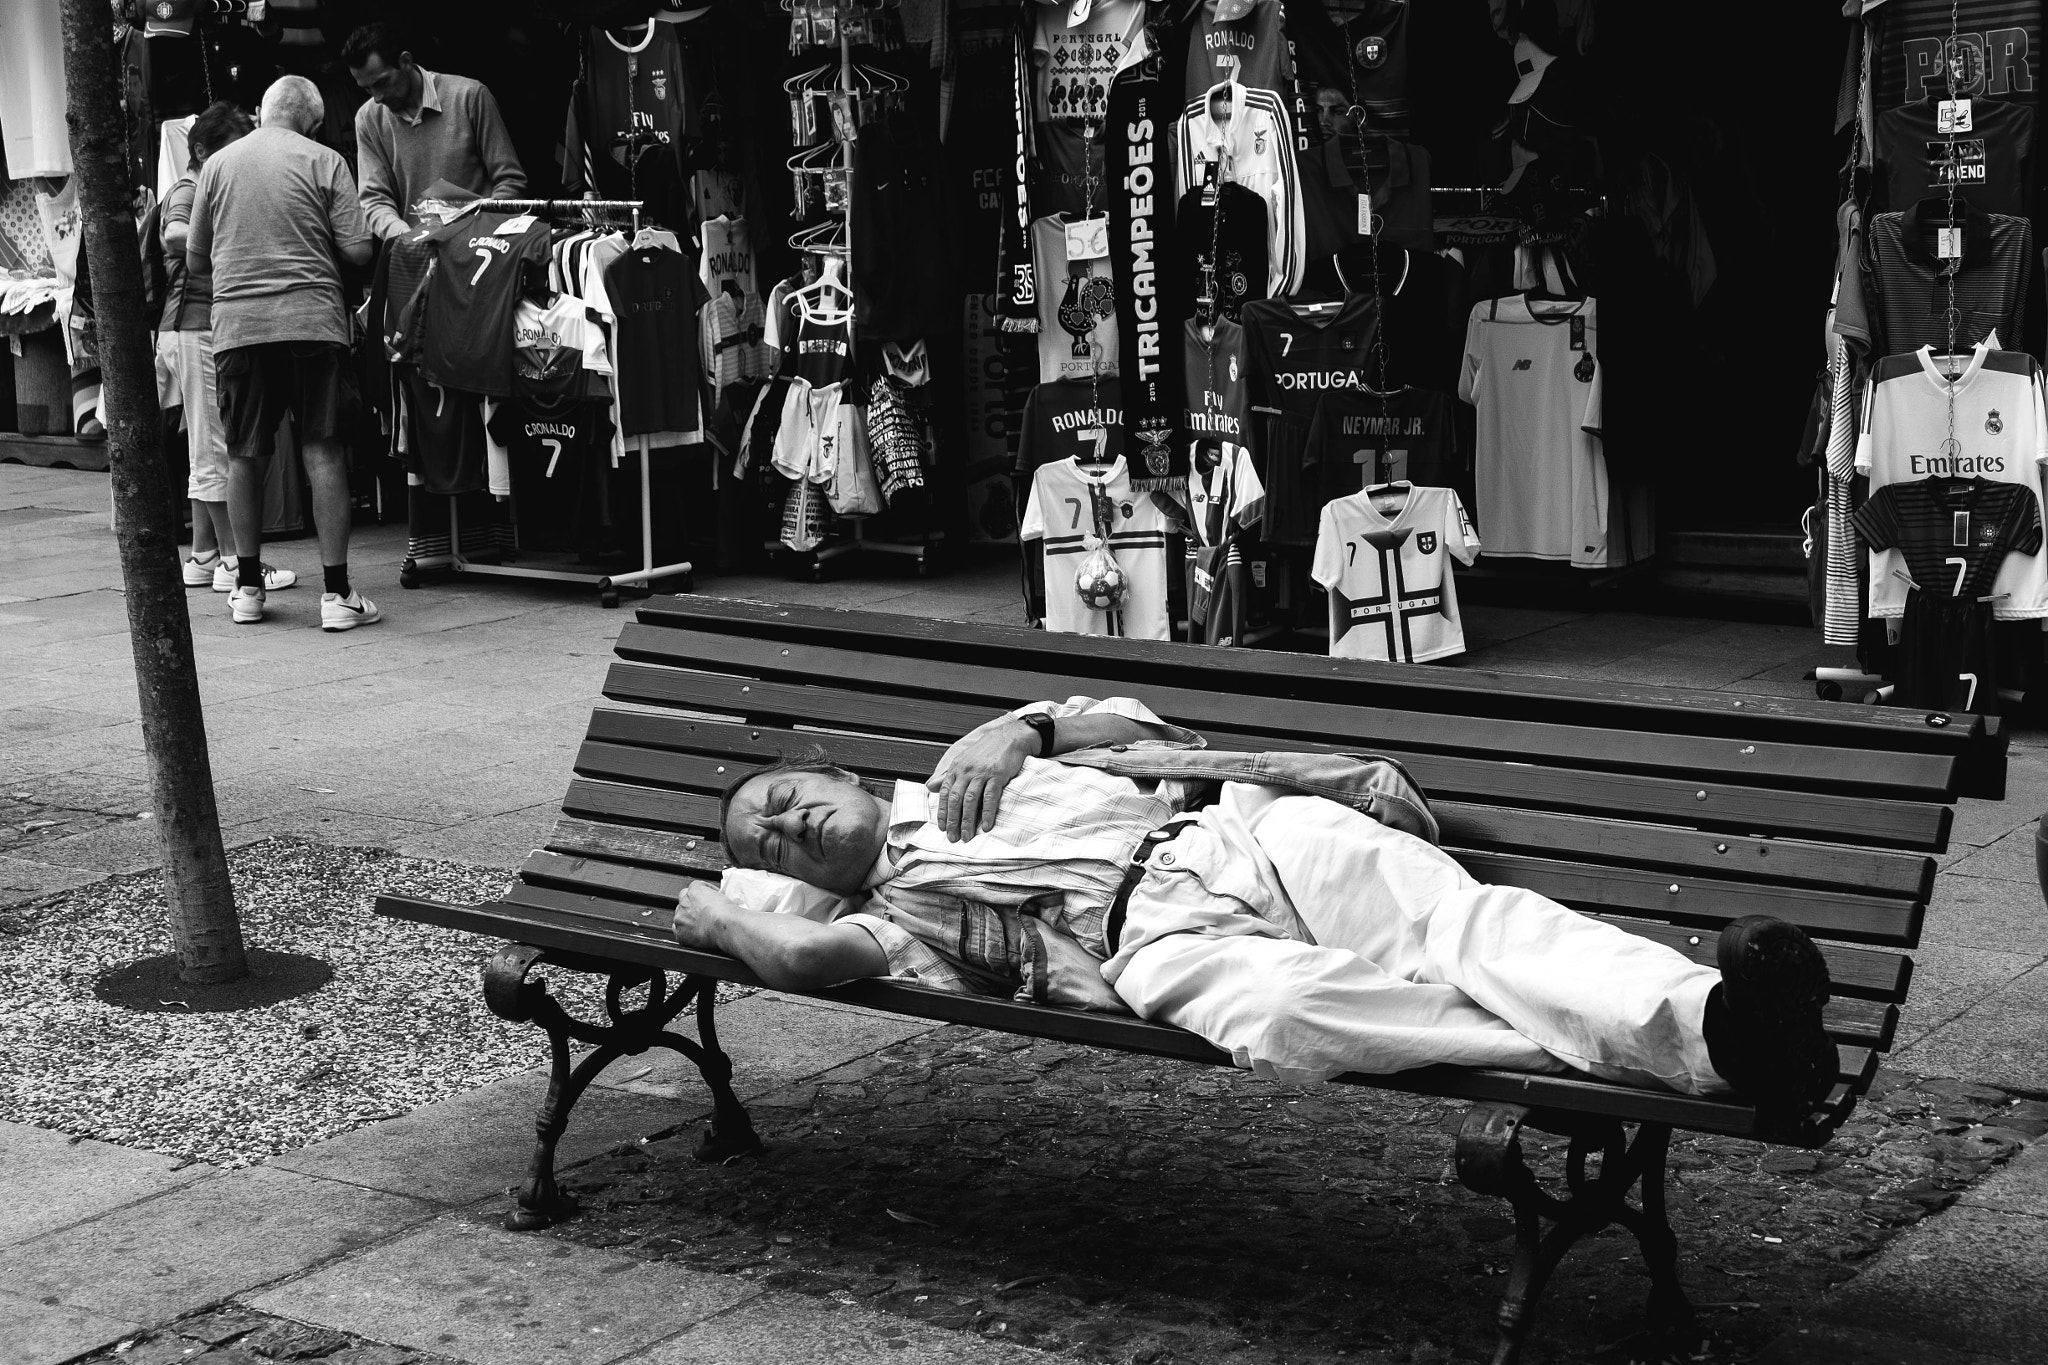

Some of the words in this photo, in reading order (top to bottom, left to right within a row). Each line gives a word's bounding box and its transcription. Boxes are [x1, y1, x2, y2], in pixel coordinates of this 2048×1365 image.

[1053, 33, 1121, 44] PORTUGAL
[1205, 29, 1256, 50] RONALDO
[1216, 54, 1242, 83] 7
[632, 111, 654, 130] Fly
[1067, 223, 1108, 258] 5€
[1123, 118, 1160, 382] TRICAMPEÕES
[470, 248, 492, 287] 7
[709, 252, 750, 278] RONALDO
[1280, 332, 1294, 358] 7
[1274, 369, 1364, 391] PORTUGA
[427, 381, 445, 417] 7
[1203, 390, 1223, 411] Fly
[1343, 416, 1400, 435] NEYMAR
[1403, 416, 1425, 435] JR.
[1077, 428, 1107, 457] 7
[541, 438, 562, 478] 7
[1352, 448, 1409, 489] 11
[1910, 454, 2005, 475] Emirates
[1064, 497, 1082, 530] 7
[1345, 541, 1357, 567] 7
[1945, 557, 1968, 598] 7
[1353, 597, 1439, 616] PORTUGAL
[1959, 672, 1978, 712] 7
